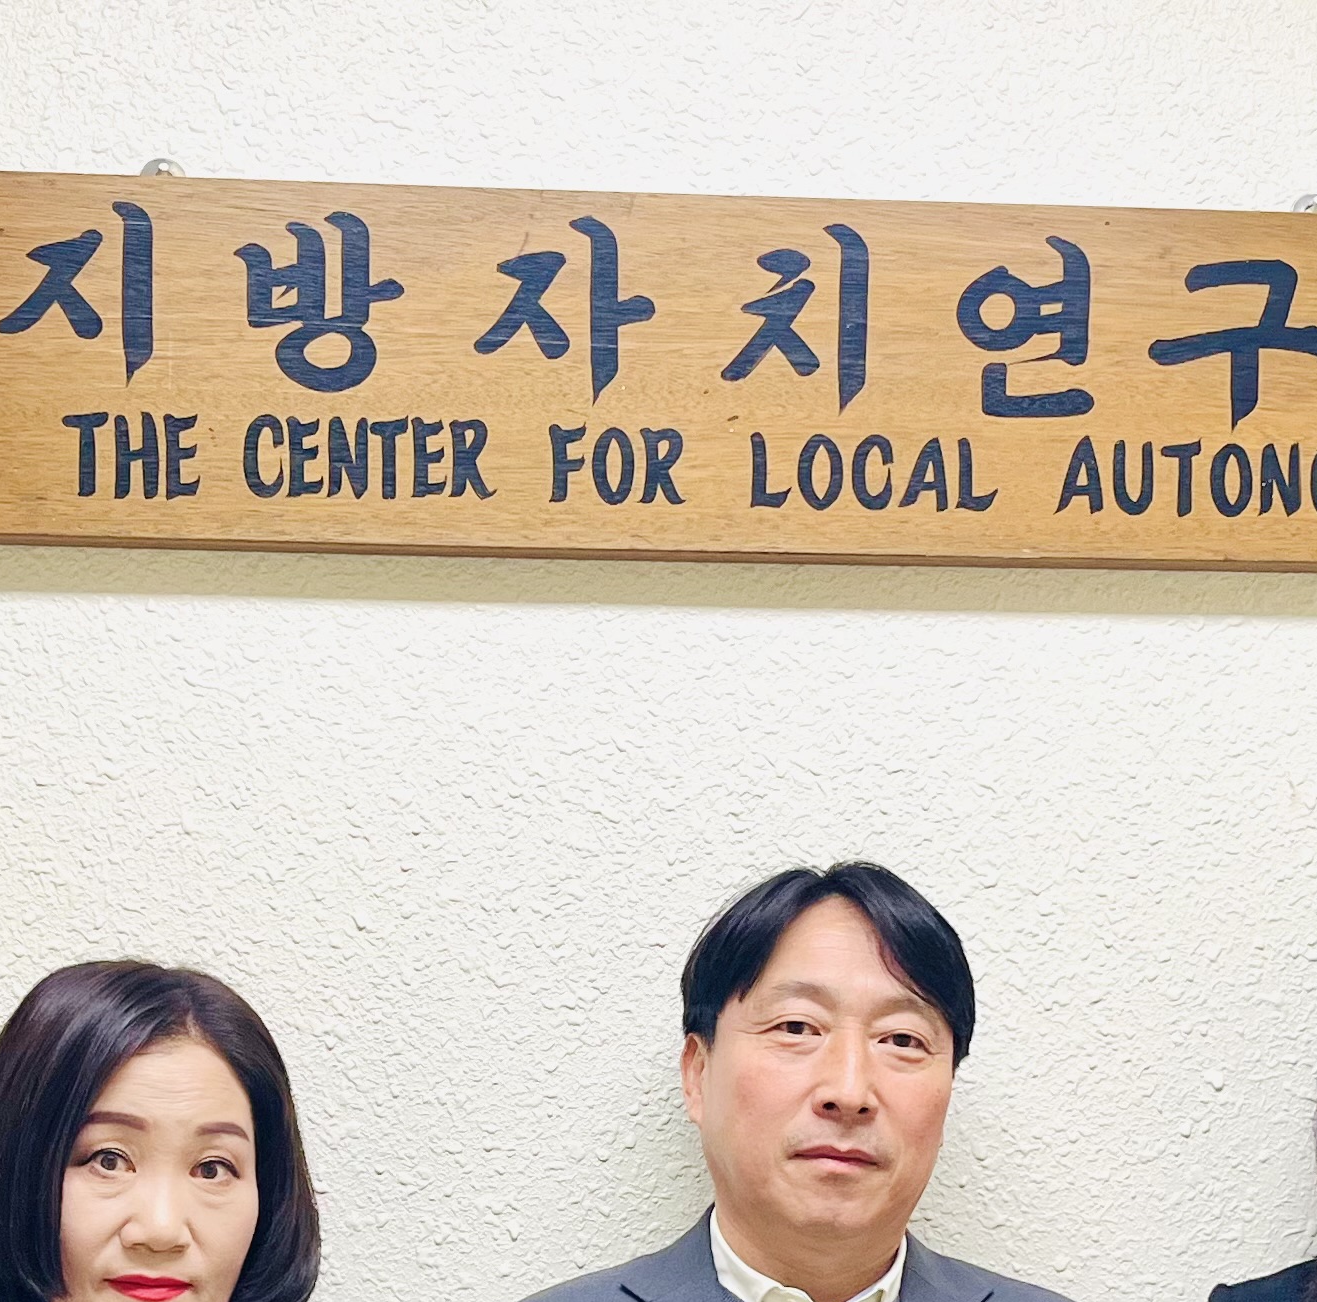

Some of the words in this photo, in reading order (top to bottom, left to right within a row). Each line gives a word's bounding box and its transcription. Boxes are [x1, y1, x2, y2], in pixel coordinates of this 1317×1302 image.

[64, 413, 198, 498] THE
[244, 415, 490, 499] CENTER
[550, 425, 683, 504] FOR
[752, 435, 994, 511] LOCAL
